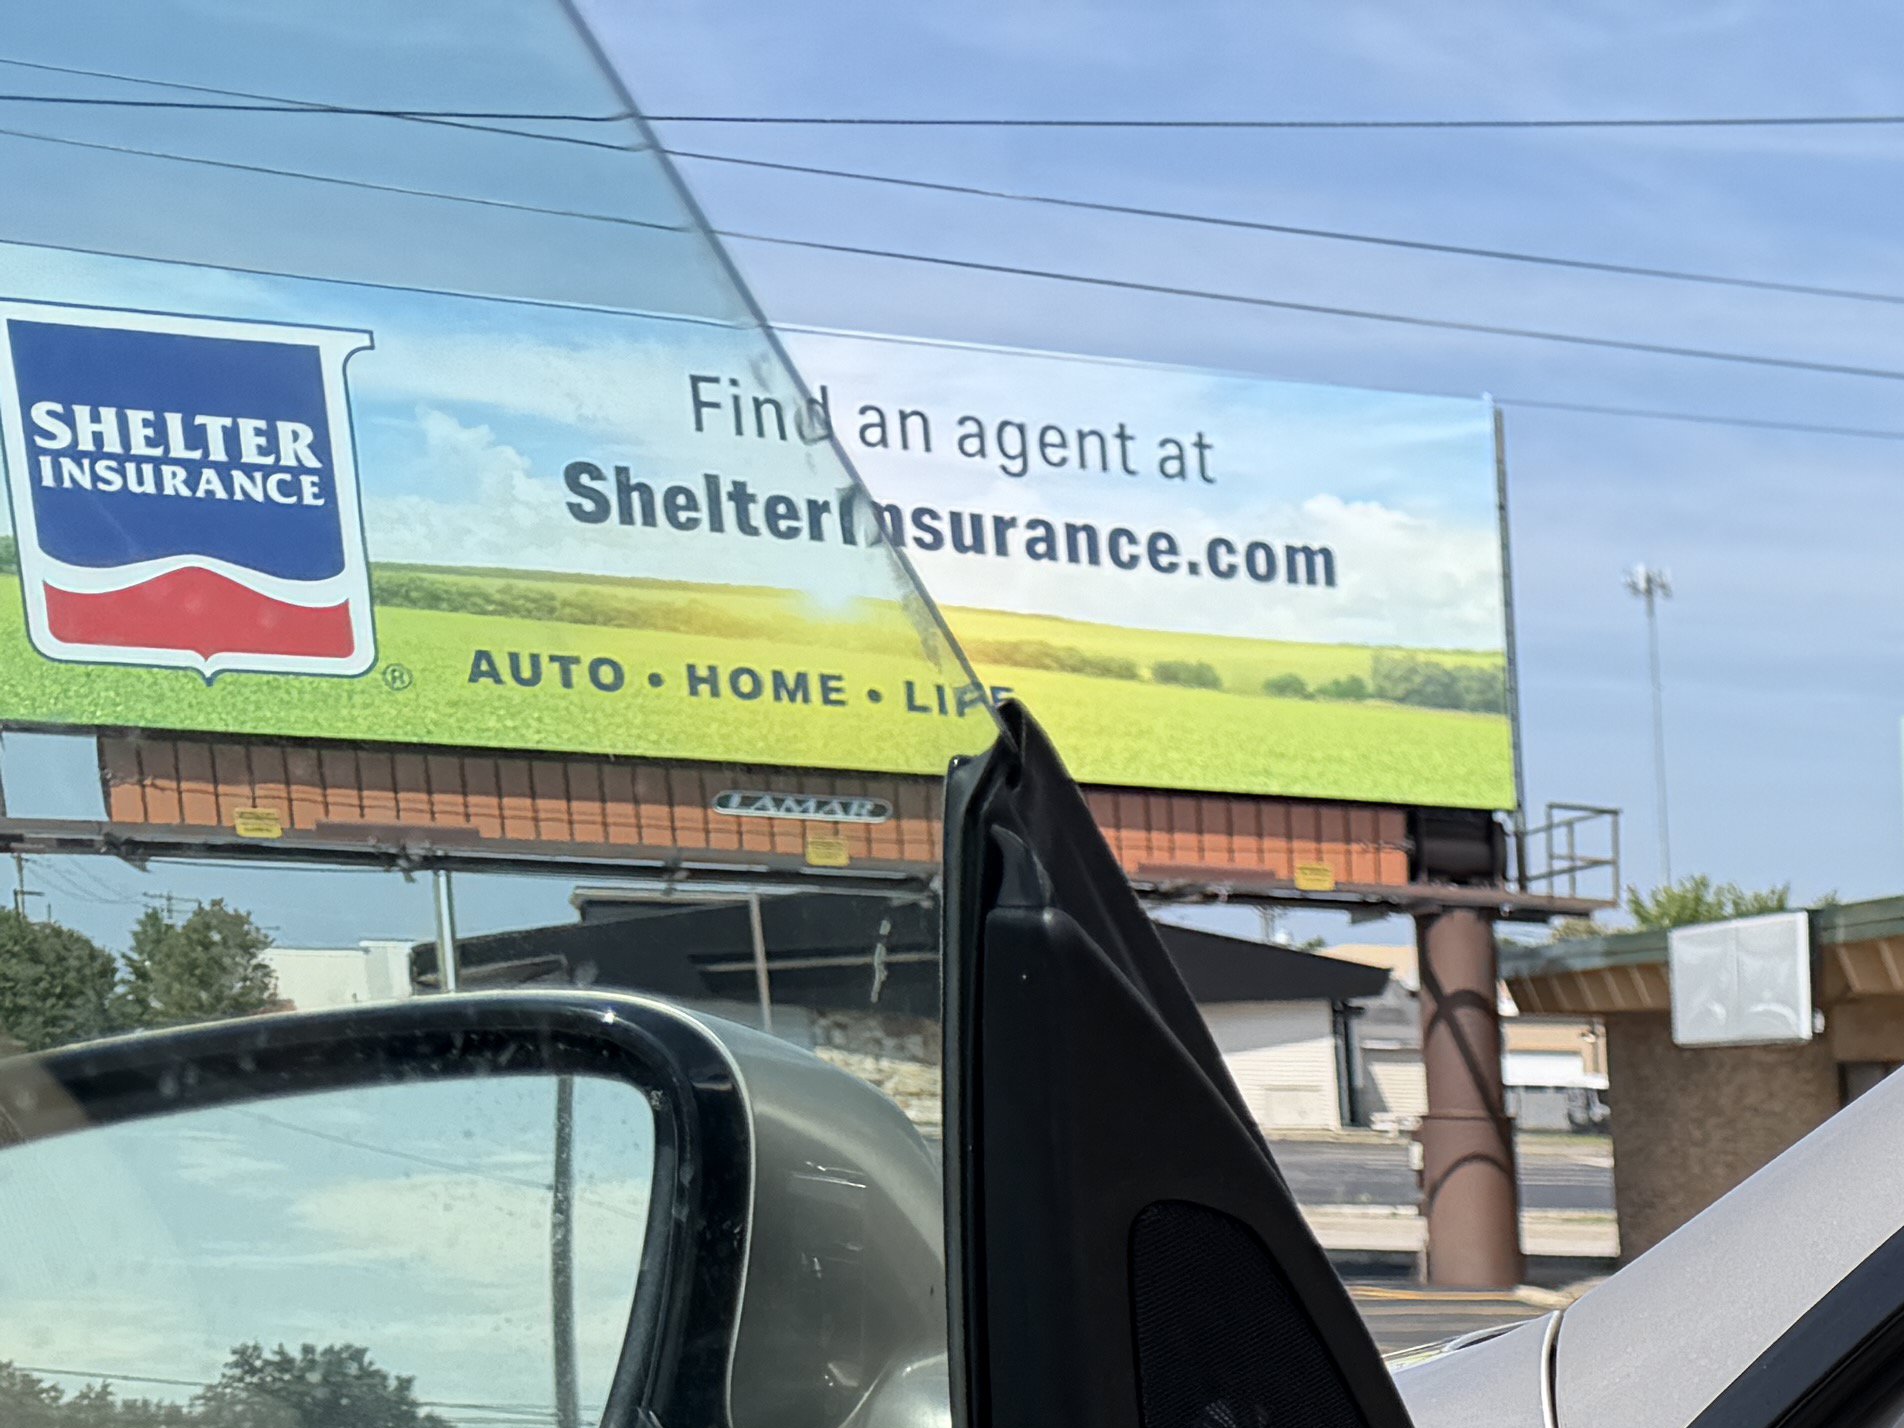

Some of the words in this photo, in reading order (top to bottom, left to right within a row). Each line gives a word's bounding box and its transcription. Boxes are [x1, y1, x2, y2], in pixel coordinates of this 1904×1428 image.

[30, 401, 323, 468] SHELTER
[689, 373, 833, 445] Find
[858, 402, 932, 453] an
[956, 413, 1138, 478] agent
[1159, 430, 1217, 485] at
[39, 454, 327, 507] INSURANCE
[564, 460, 1338, 588] ShelterInsurance.com
[469, 649, 627, 694] AUTO
[687, 663, 847, 707] HOME
[729, 792, 876, 818] LAMAR
